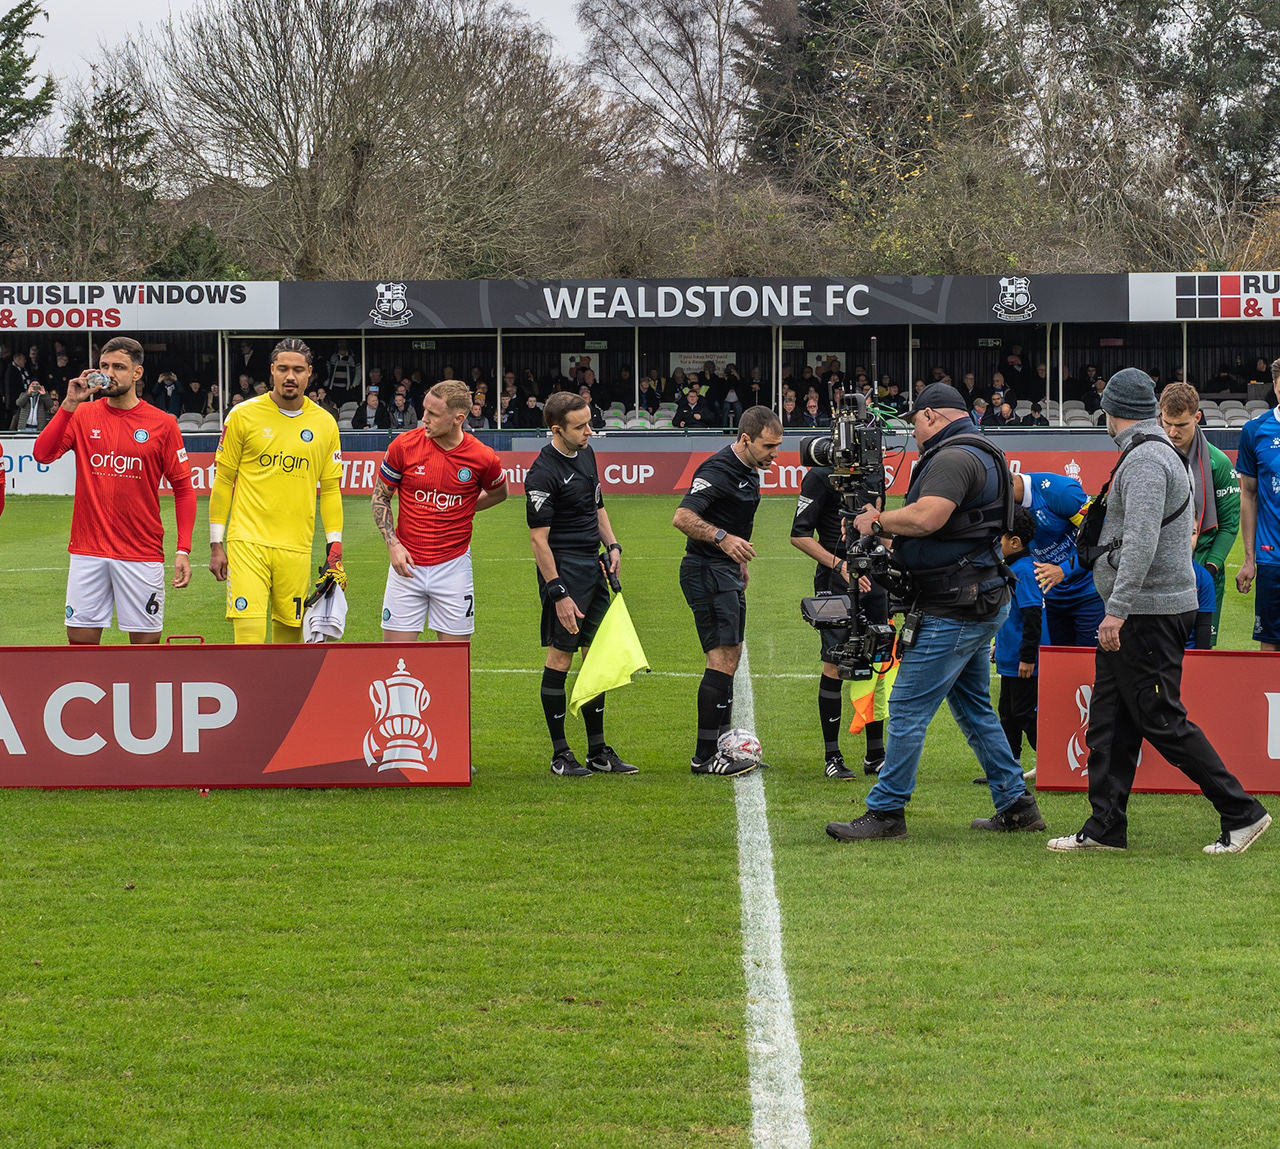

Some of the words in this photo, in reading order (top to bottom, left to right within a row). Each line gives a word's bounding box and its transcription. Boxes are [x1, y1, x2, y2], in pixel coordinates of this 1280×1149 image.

[543, 285, 812, 319] WEALDSTONE
[825, 284, 870, 316] FC
[1243, 298, 1264, 317] &
[26, 308, 122, 328] DOORS
[90, 451, 143, 473] origin
[259, 451, 309, 473] origin
[604, 464, 654, 484] CUP
[414, 489, 462, 510] origin
[145, 592, 159, 615] 6
[293, 597, 302, 620] 1
[43, 681, 239, 756] CUP
